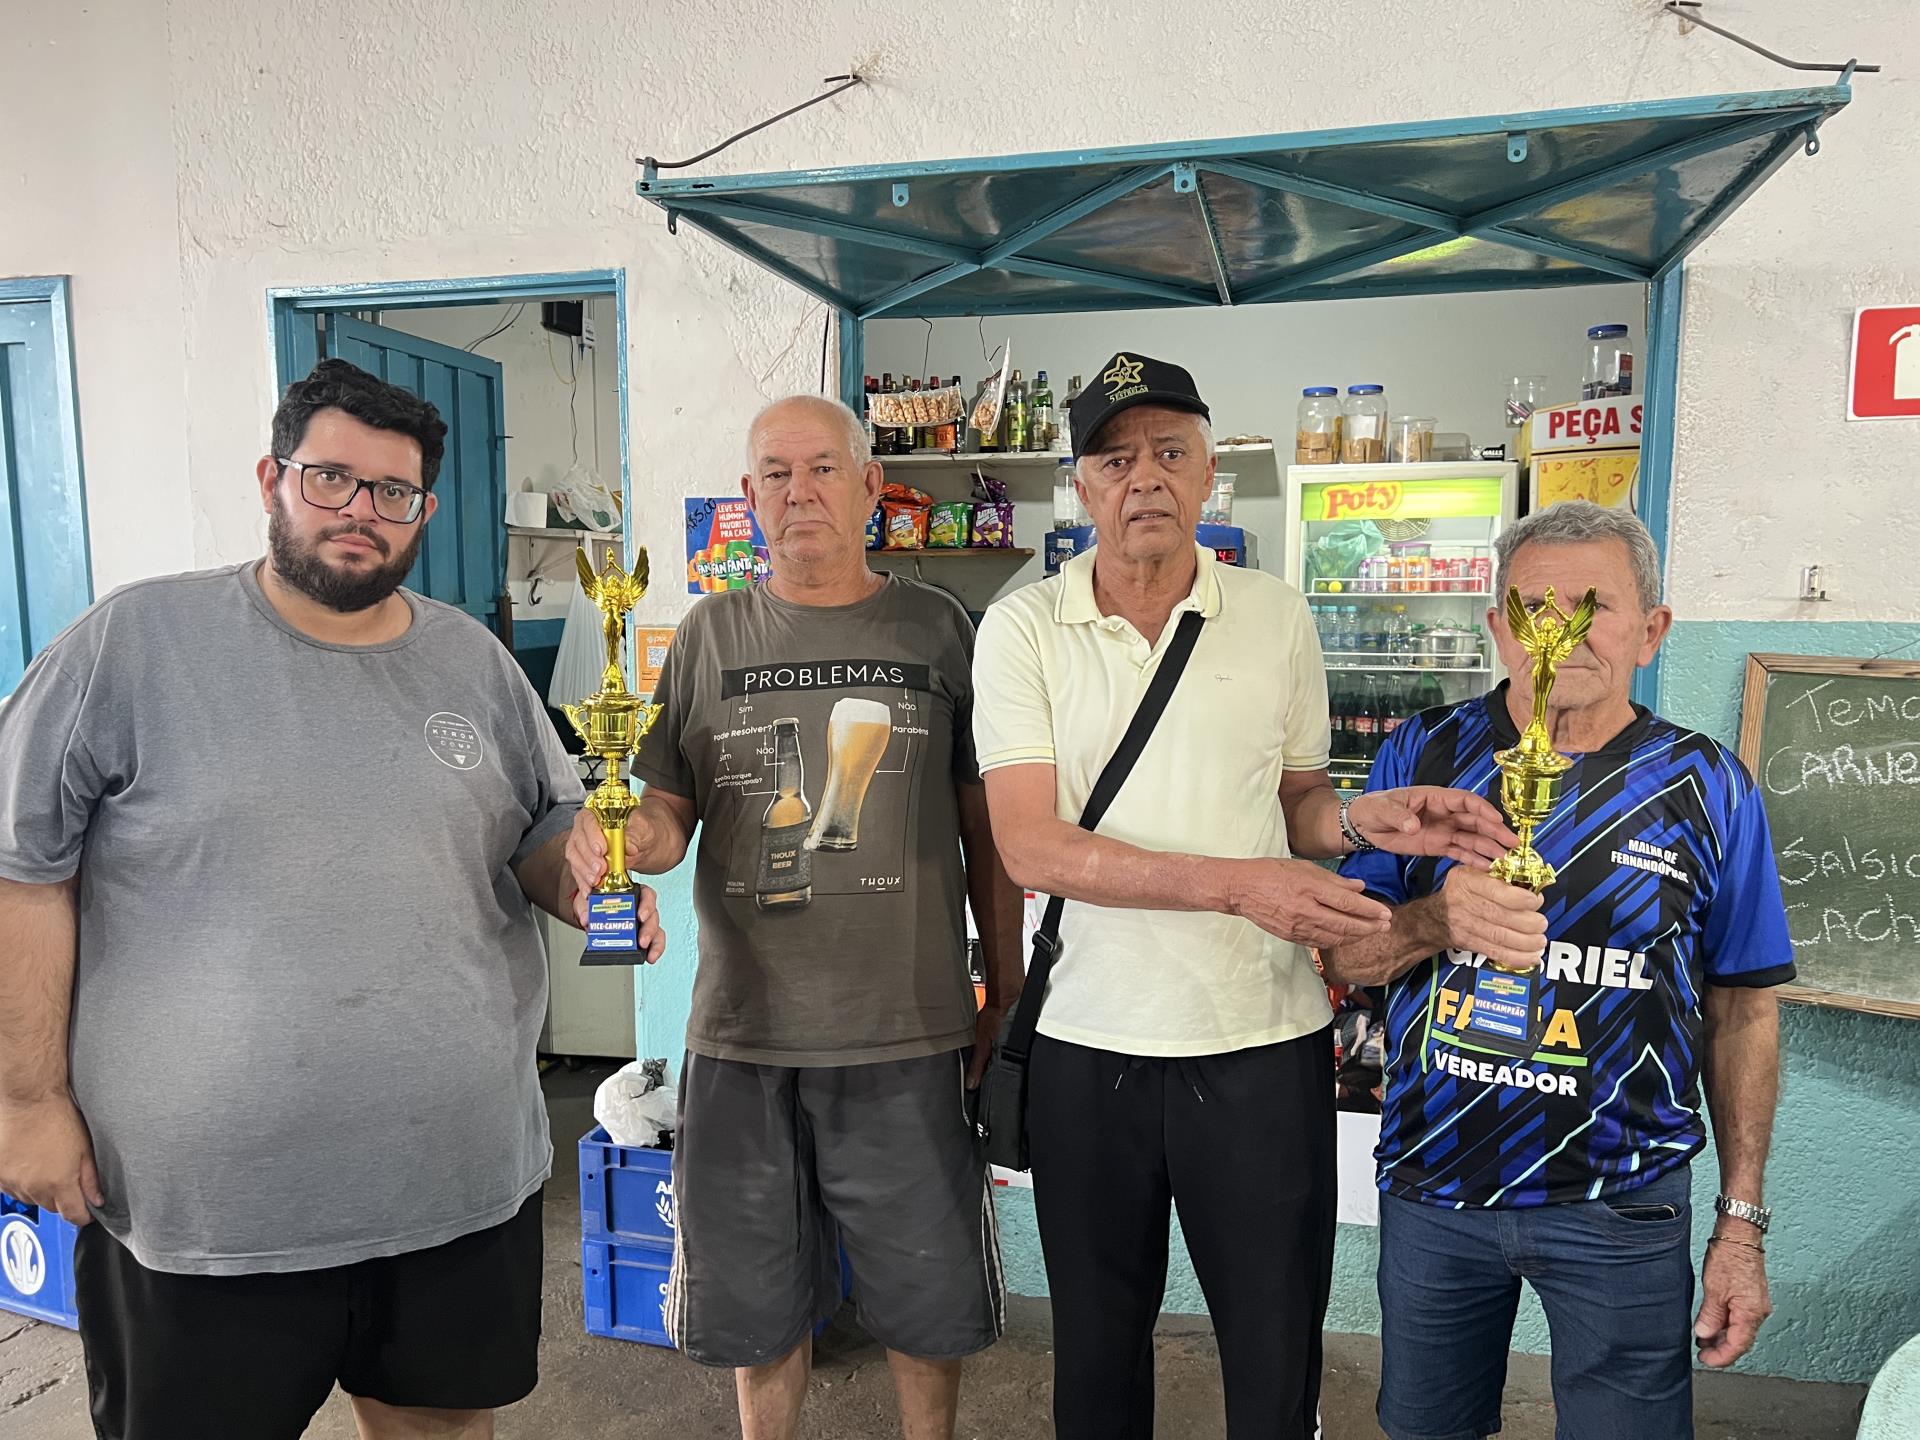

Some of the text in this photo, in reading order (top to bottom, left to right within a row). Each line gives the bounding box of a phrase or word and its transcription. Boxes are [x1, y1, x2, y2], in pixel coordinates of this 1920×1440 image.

[1115, 385, 1149, 401] ESTRELAS
[1549, 407, 1621, 444] PEÇA
[1326, 483, 1398, 519] Poty
[717, 503, 747, 513] LEVE SEU
[718, 512, 744, 520] HUMMM
[719, 520, 751, 530] FAVORITO
[721, 529, 752, 538] PRA CASA
[744, 664, 904, 691] PROBLEMAS
[738, 705, 753, 714] Sim
[897, 701, 917, 711] Não
[731, 724, 773, 737] Resolver?
[756, 746, 775, 756] Não
[770, 849, 797, 860] THOUX
[1628, 839, 1679, 864] MALHA DE
[772, 860, 792, 870] BEER
[860, 876, 901, 886] THOUX
[589, 920, 634, 930] VICE-CAMPEÃO
[1475, 998, 1526, 1018] VICE-CAMPEÃO
[1434, 1049, 1578, 1097] VEREADOR
